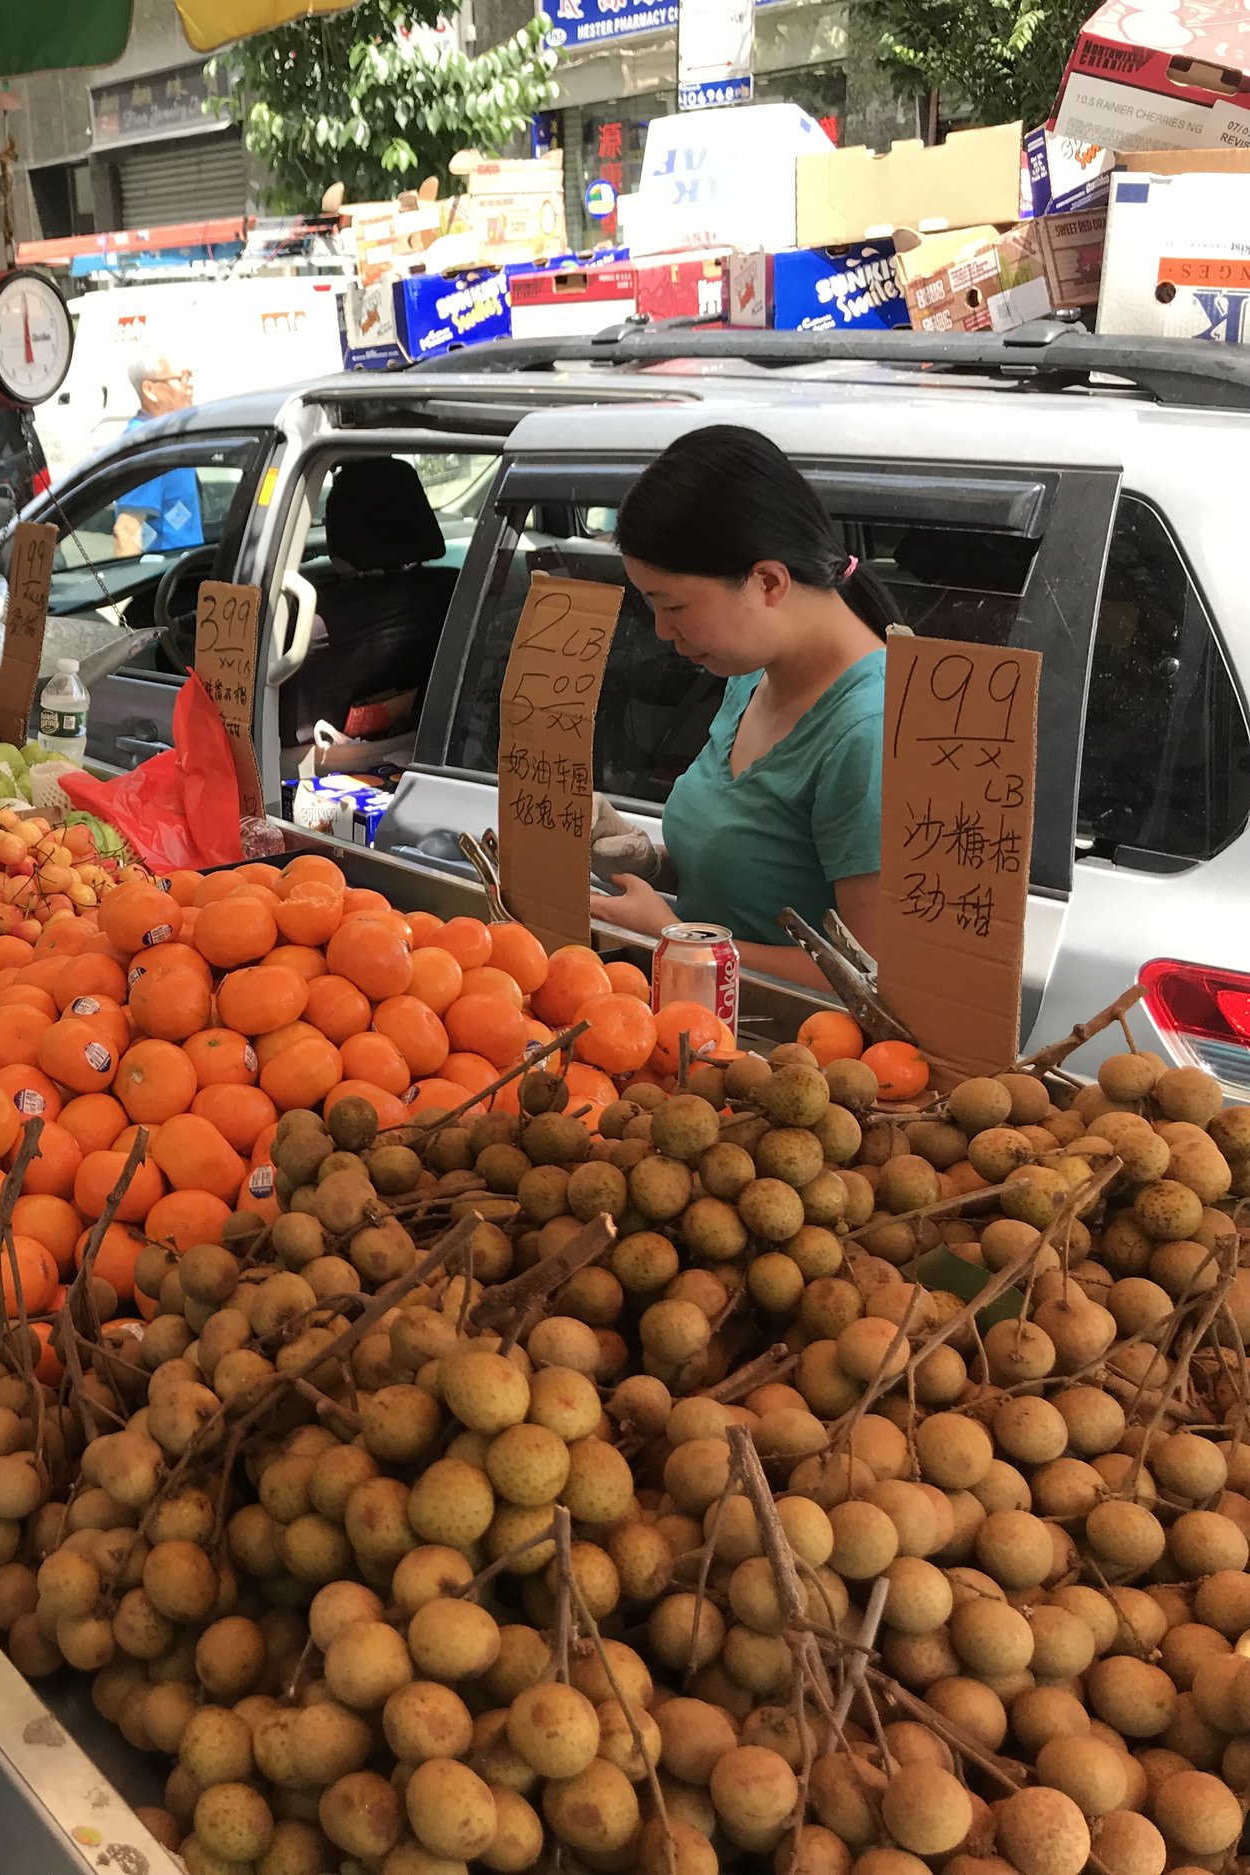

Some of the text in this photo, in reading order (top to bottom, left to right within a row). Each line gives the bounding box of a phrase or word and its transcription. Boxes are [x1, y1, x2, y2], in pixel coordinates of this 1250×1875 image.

[614, 8, 668, 33] PHARMACY
[1076, 94, 1095, 107] 10.5
[1096, 98, 1134, 117] RAINIER
[1135, 109, 1186, 129] CHERRIES
[1187, 122, 1204, 135] NG
[1054, 224, 1078, 238] SWEET
[199, 595, 251, 652] 399
[894, 654, 1021, 758] 199
[984, 774, 1024, 808] LB
[717, 959, 737, 1025] Coke
